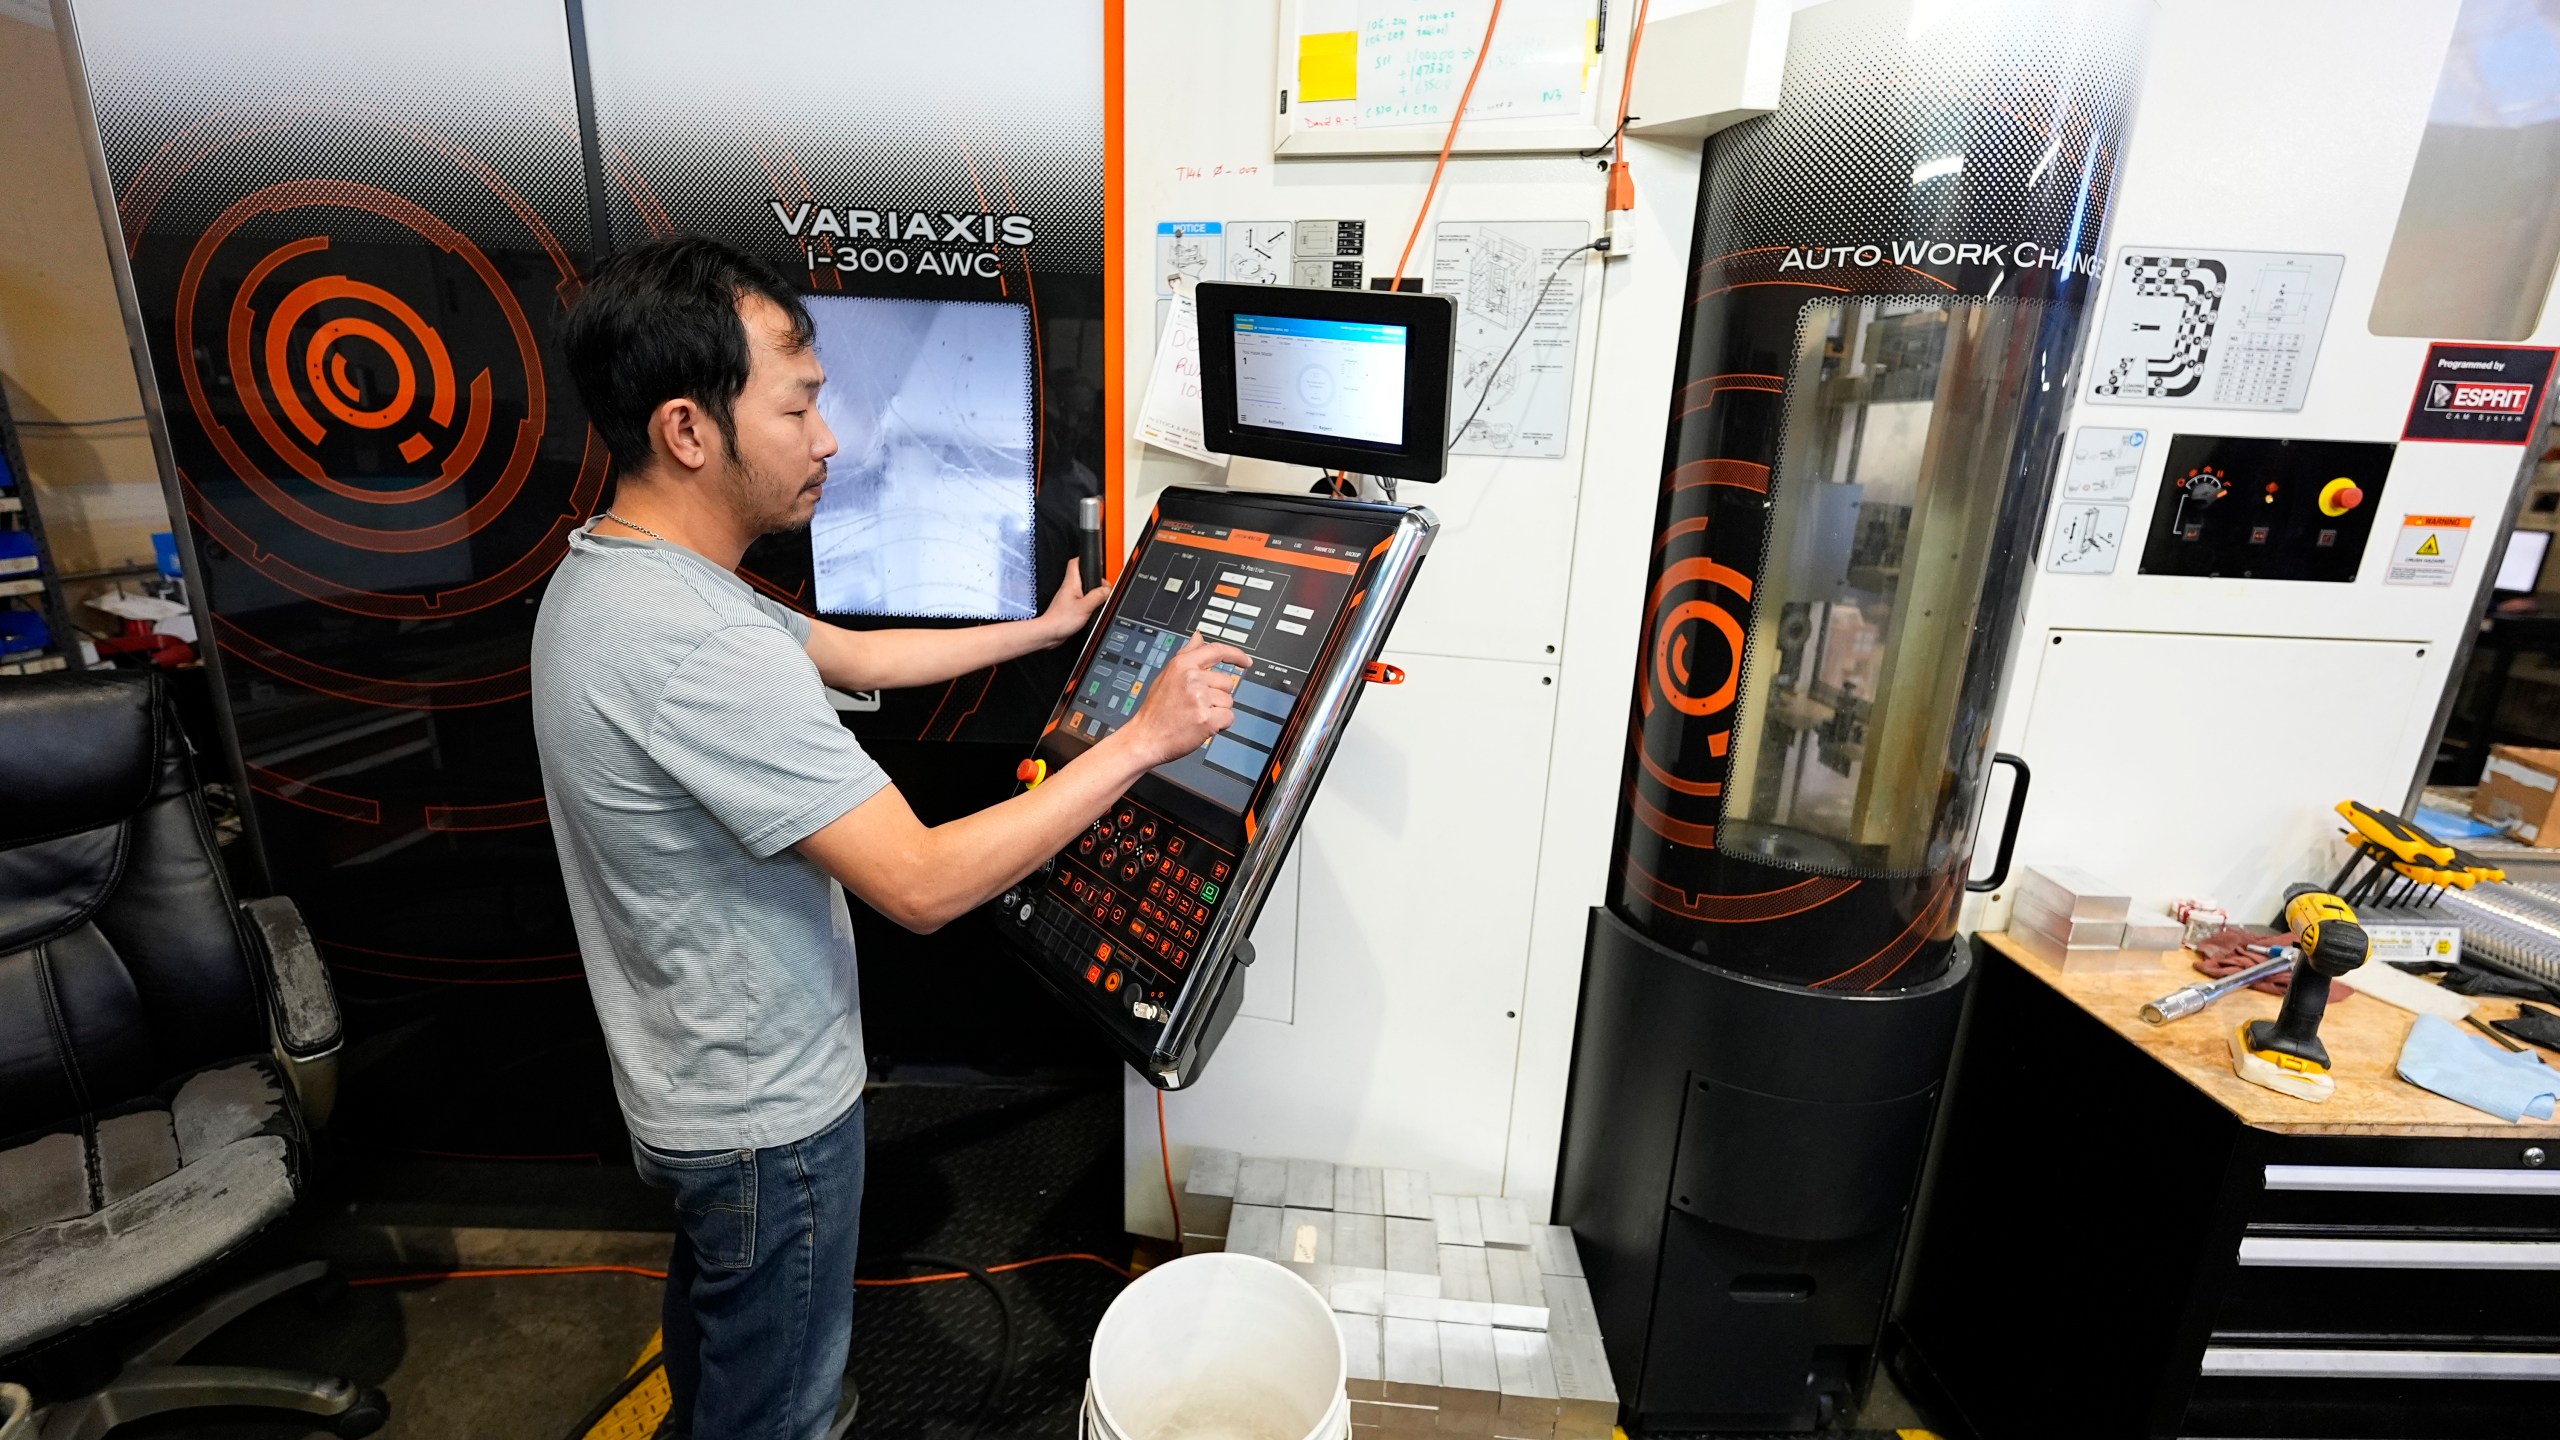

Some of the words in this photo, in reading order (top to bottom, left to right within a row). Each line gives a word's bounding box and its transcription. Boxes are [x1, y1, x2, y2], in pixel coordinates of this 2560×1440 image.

[769, 200, 1035, 247] VARIAXIS
[1172, 223, 1206, 234] NOTICE
[1777, 243, 1883, 273] AUTO
[1890, 239, 2008, 267] WORK
[914, 250, 1002, 279] AWC
[1243, 356, 1247, 365] 1
[2437, 358, 2494, 371] Programmed
[2493, 360, 2506, 372] by
[2453, 387, 2528, 409] ESPRIT
[2445, 412, 2471, 421] CAM
[2477, 413, 2523, 423] System
[2425, 517, 2462, 526] WARNING
[1313, 545, 1337, 554] PARAMETER
[1246, 565, 1265, 574] Position
